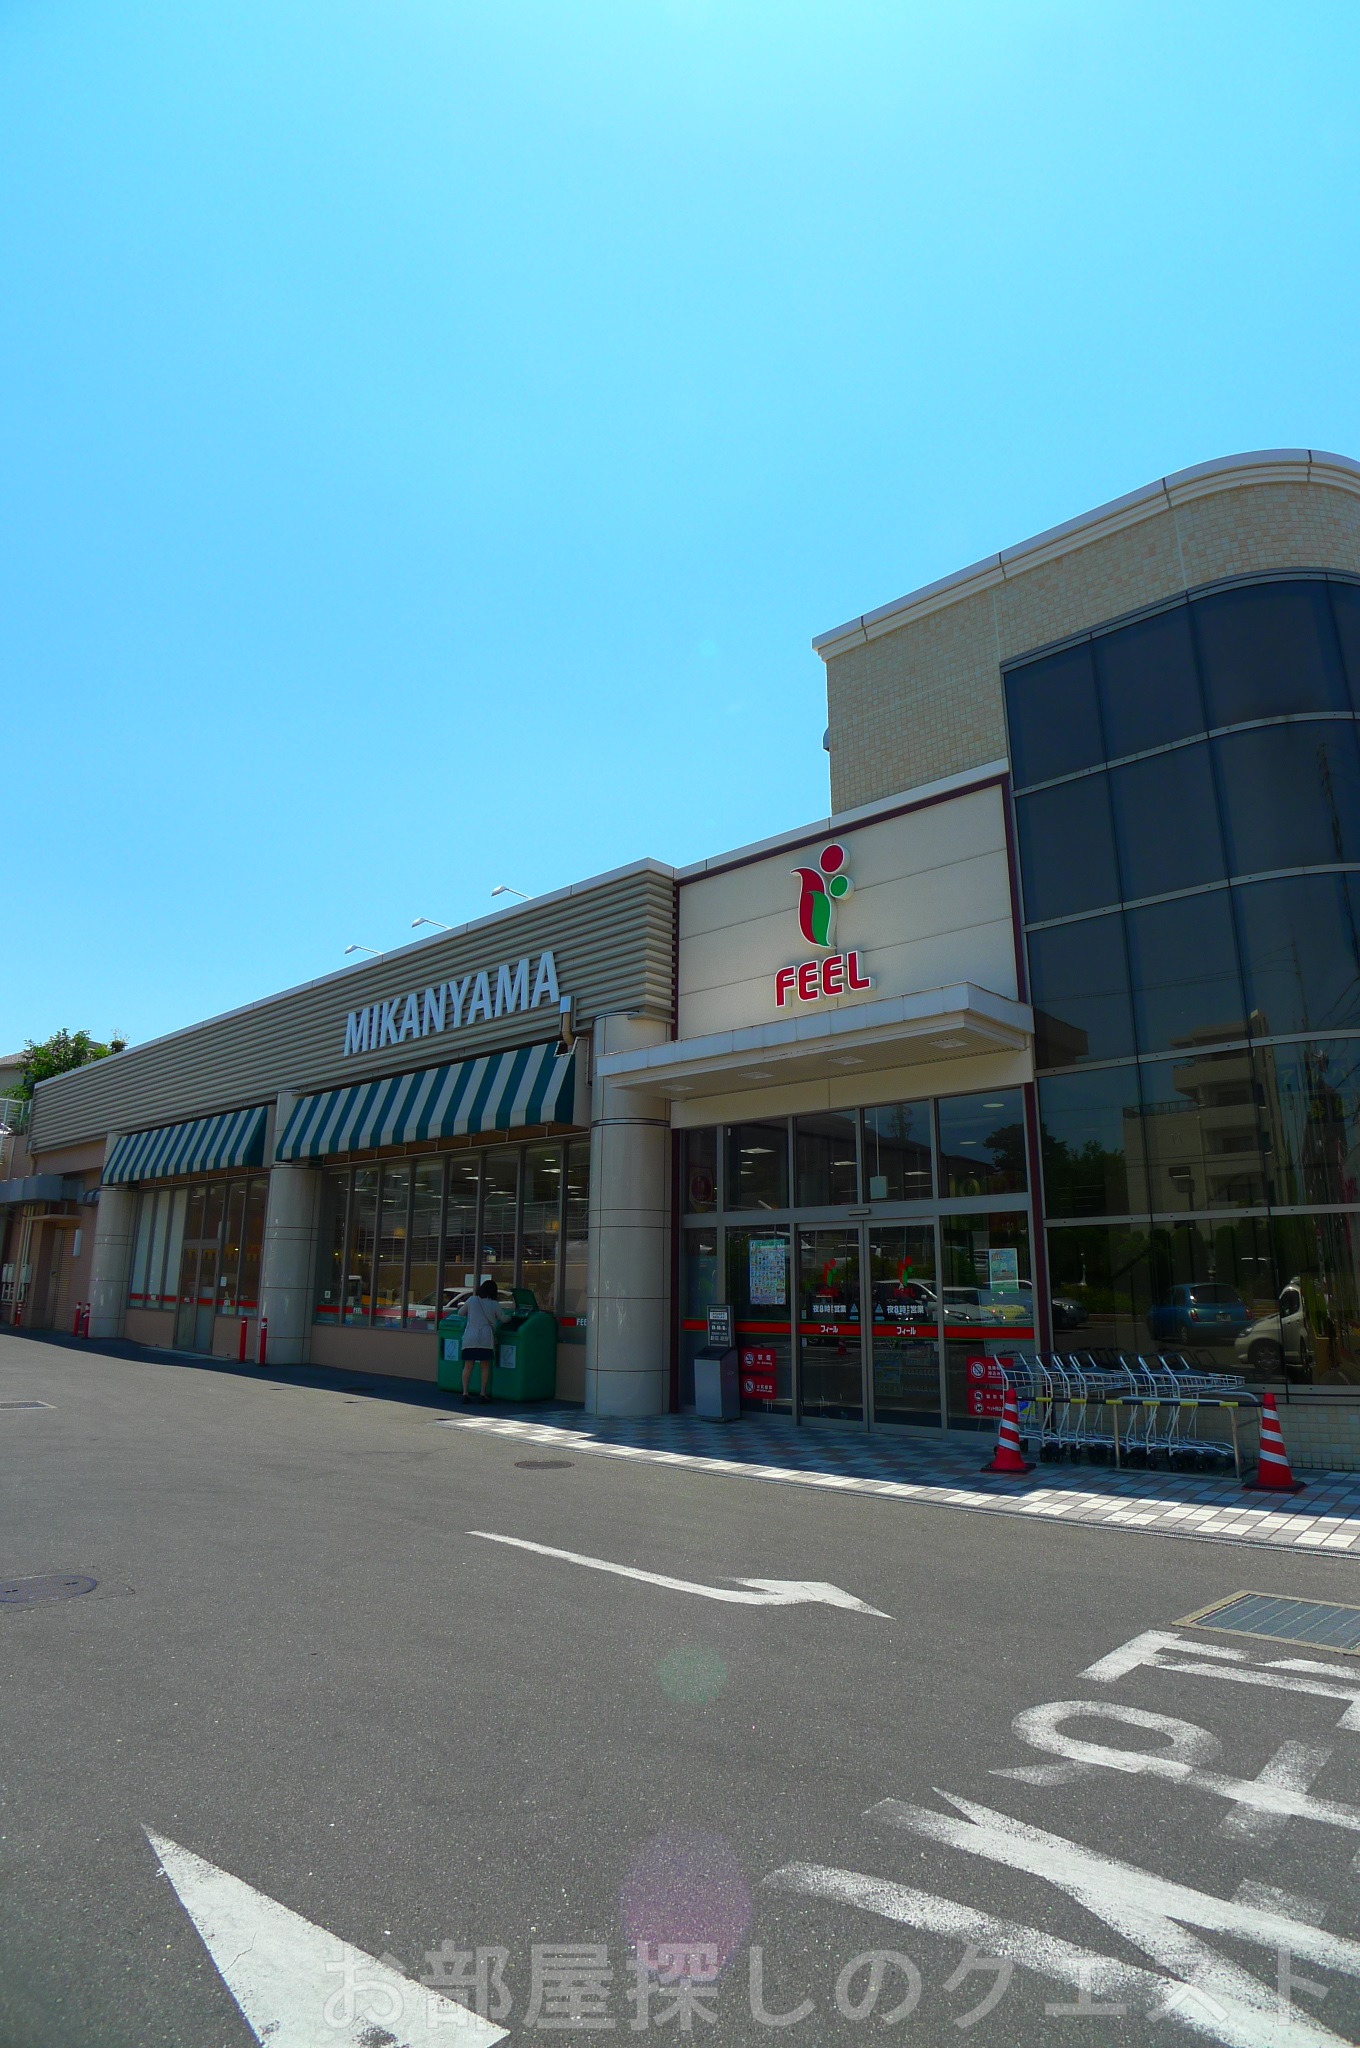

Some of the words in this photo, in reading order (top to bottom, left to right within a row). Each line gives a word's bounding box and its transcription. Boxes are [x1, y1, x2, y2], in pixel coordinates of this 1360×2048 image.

[774, 950, 871, 1008] FEEL
[343, 950, 560, 1057] MIKANYAMA
[820, 1325, 839, 1334] フィール
[896, 1326, 917, 1336] フィール
